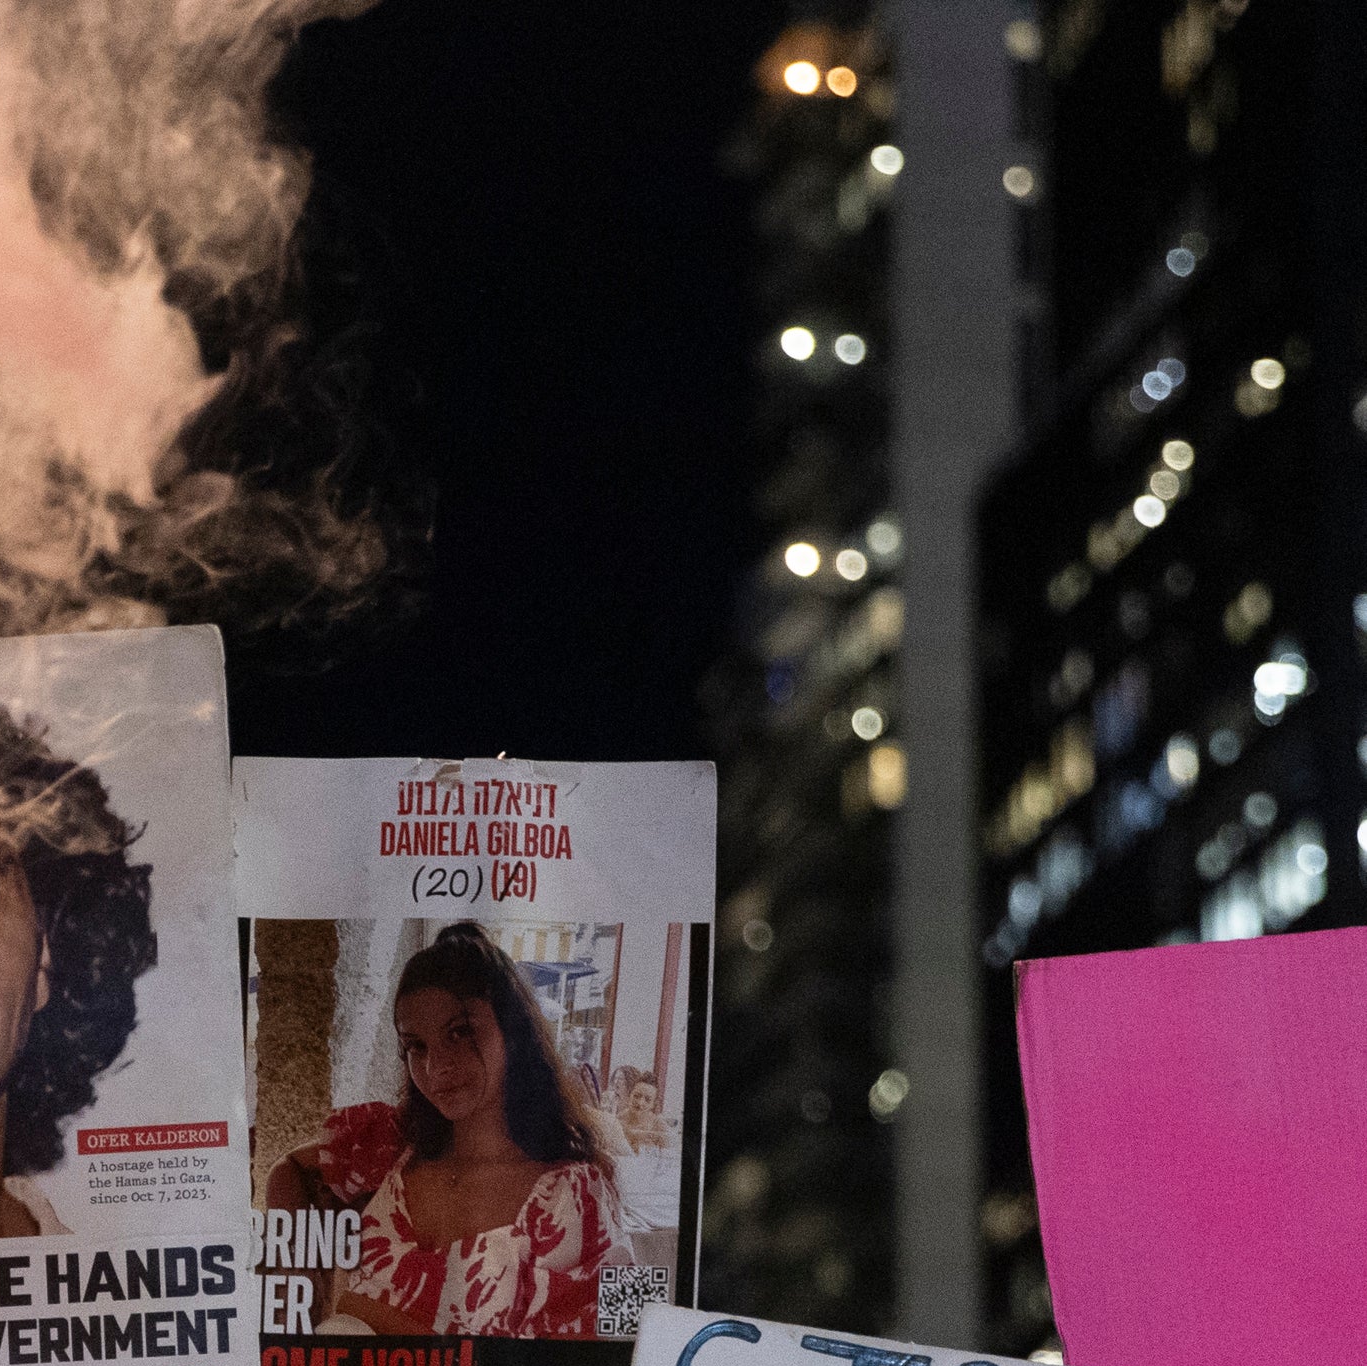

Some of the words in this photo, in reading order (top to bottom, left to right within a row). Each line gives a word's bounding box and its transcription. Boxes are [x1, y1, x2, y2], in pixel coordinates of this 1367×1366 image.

[380, 821, 480, 856] DANIELA
[487, 821, 572, 860] GILBOA
[412, 865, 483, 903] (20)
[87, 1133, 130, 1149] OFER
[134, 1128, 220, 1146] KALDERON
[88, 1162, 97, 1173] A
[101, 1159, 154, 1173] hostage
[157, 1156, 188, 1169] held
[192, 1156, 208, 1170] by
[89, 1177, 112, 1188] the
[116, 1175, 157, 1187] Hamas
[161, 1173, 176, 1185] in
[179, 1172, 216, 1184] Gaza,
[90, 1193, 128, 1205] since
[131, 1191, 154, 1203] Oct
[158, 1191, 171, 1203] 7,
[175, 1188, 211, 1201] 2023.
[45, 1244, 236, 1305] HANDS
[256, 1274, 314, 1335] ER
